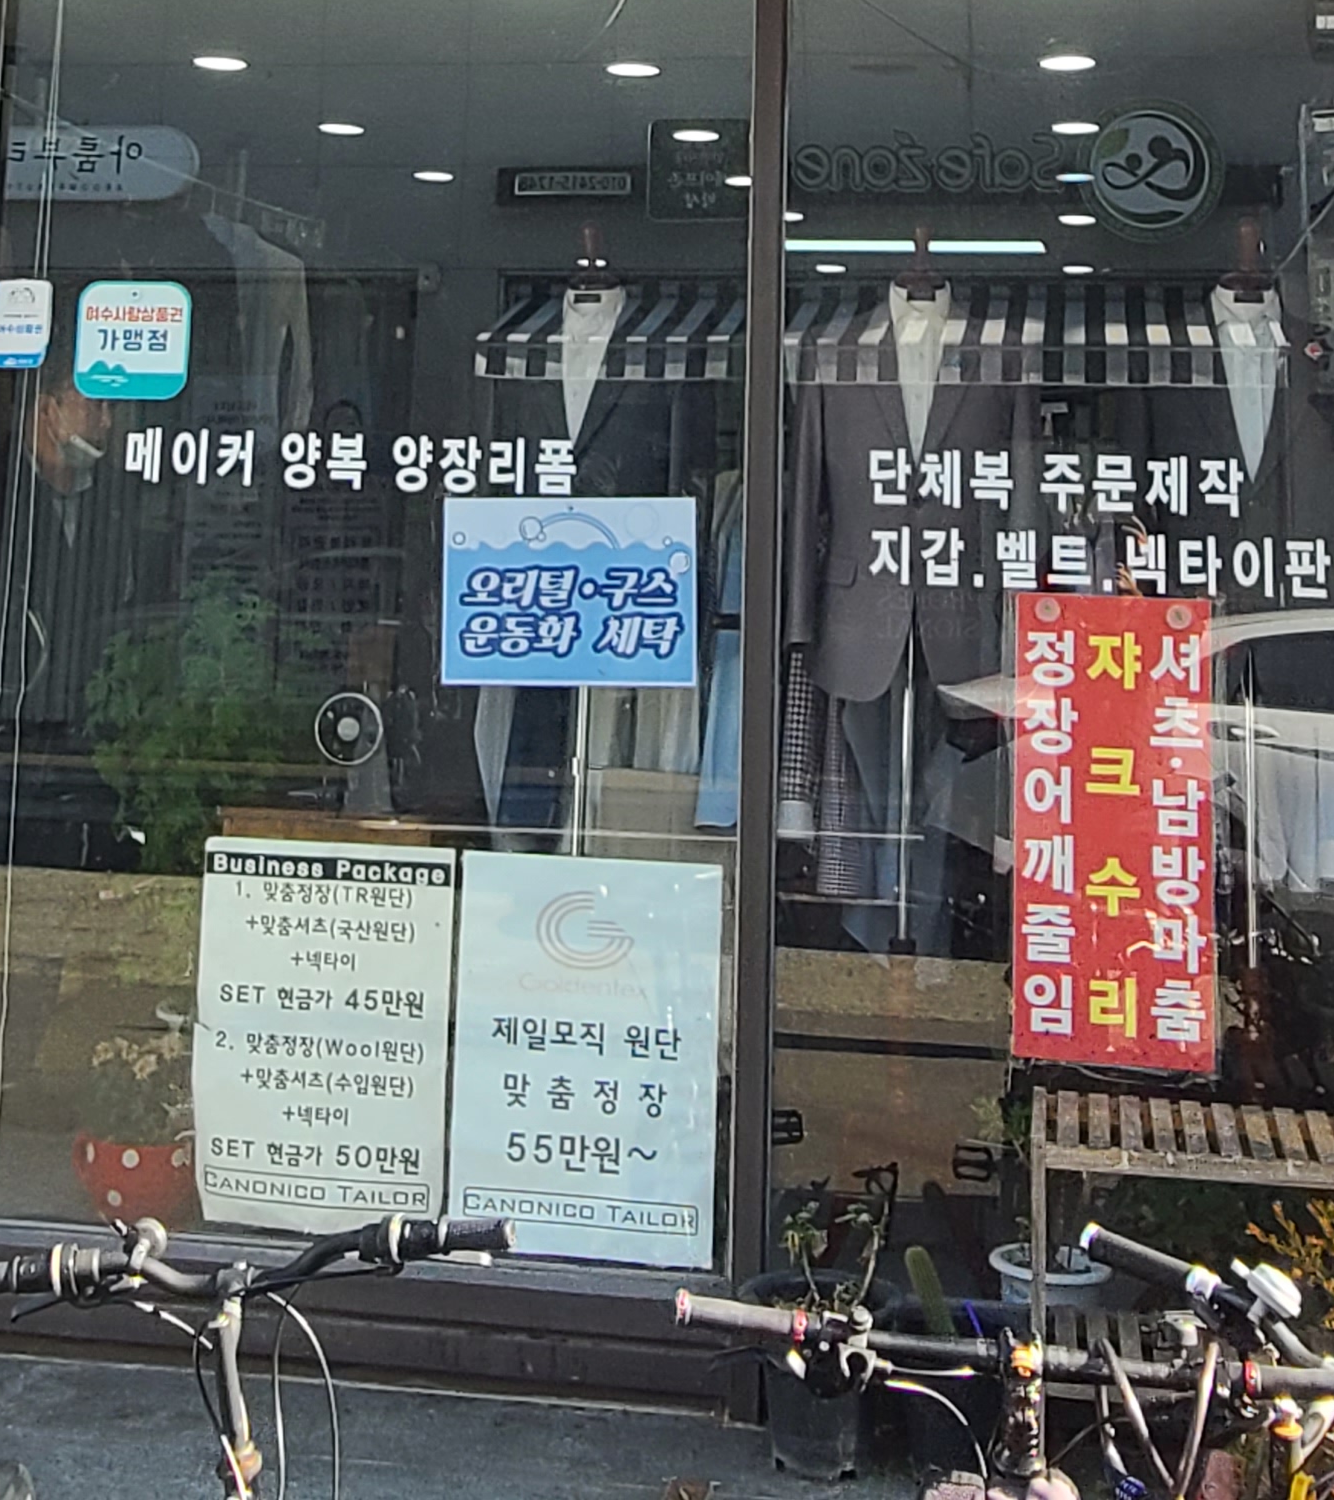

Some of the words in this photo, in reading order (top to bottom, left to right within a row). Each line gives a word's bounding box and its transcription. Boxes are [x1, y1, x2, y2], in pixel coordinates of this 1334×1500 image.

[96, 328, 169, 352] 가맹점
[125, 426, 255, 487] 메이커
[280, 431, 367, 491] 양복
[392, 435, 577, 496] 양장리폼
[868, 447, 1014, 510] 단체복
[1040, 452, 1244, 518] 주문제작
[461, 613, 579, 657] 운동화
[592, 613, 681, 657] 세탁
[1022, 630, 1078, 1036] 정장어깨줄임
[1085, 632, 1142, 1038] 쟈크수리
[212, 853, 325, 879] Business
[335, 859, 447, 887] Package
[234, 880, 251, 899] 1.
[262, 881, 414, 908] 맞춤정장(TR원단)
[245, 914, 416, 943] +맞춤셔츠(국산원단)
[290, 950, 358, 972] +넥타이
[219, 984, 265, 1004] SET
[277, 986, 333, 1012] 현금가
[344, 987, 426, 1018] 45만원
[215, 1030, 235, 1050] 2.
[246, 1031, 425, 1064] 맞춤정장(Wool원단)
[491, 1015, 605, 1056] 제일모직
[623, 1024, 682, 1061] 원단
[240, 1067, 415, 1099] +맞춤셔츠(수입원단)
[282, 1106, 350, 1127] +넥타이
[210, 1137, 256, 1159] SET
[266, 1141, 323, 1168] 현금가
[335, 1143, 421, 1176] 50만원
[506, 1131, 658, 1175] 55만원~
[204, 1170, 326, 1201] CANONICO
[336, 1184, 427, 1207] TAILOR
[465, 1192, 595, 1221] CANONICO
[606, 1205, 696, 1231] TAILOR
